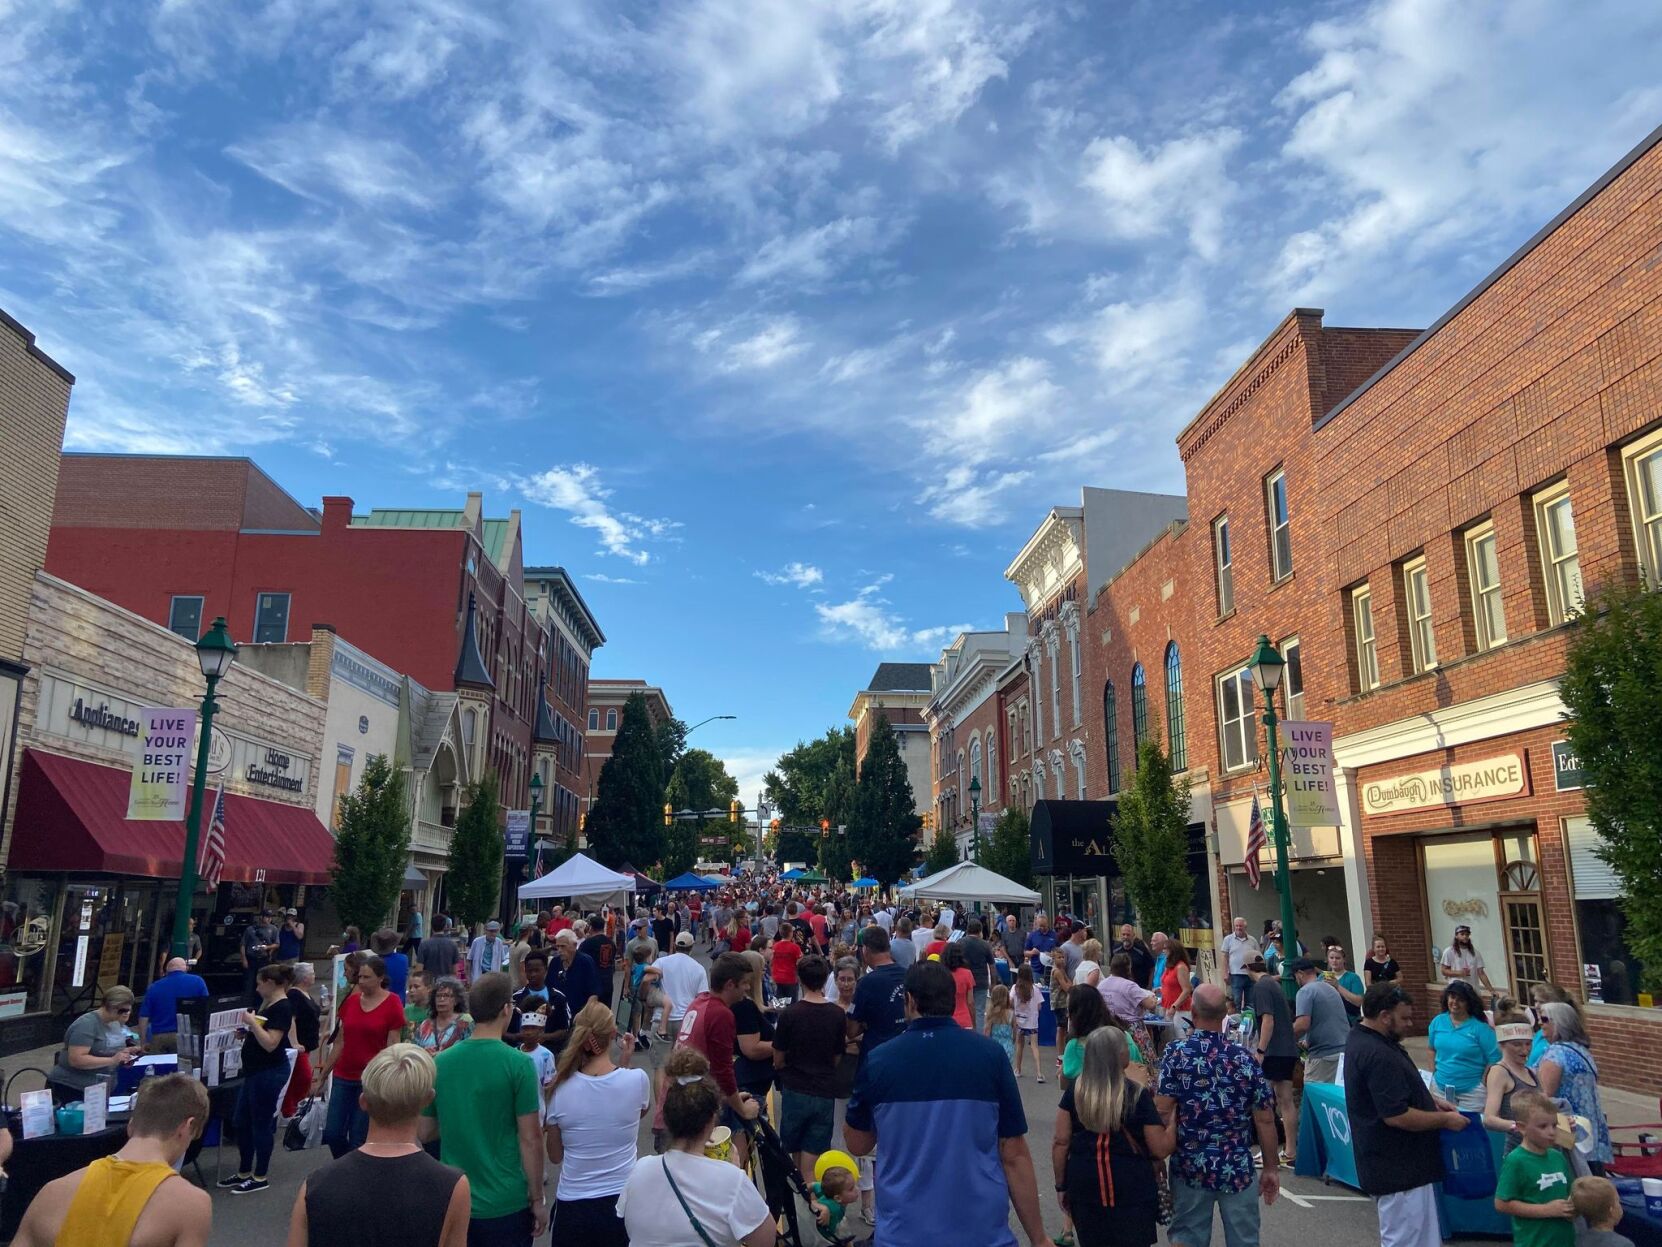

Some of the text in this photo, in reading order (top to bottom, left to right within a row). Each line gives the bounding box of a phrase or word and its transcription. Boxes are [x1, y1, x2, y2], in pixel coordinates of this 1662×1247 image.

[72, 698, 140, 737] Appliances
[150, 719, 185, 731] LIVE
[144, 736, 187, 748] YOUR
[1291, 730, 1322, 742] LIVE
[266, 747, 290, 769] Home
[1290, 747, 1327, 758] YOUR
[143, 754, 183, 766] BEST
[1293, 764, 1327, 775] BEST
[141, 772, 180, 784] LIFE!
[248, 763, 303, 793] Entertainment
[1294, 780, 1329, 792] LIFE!
[1367, 764, 1519, 809] Dumbaugh INSURANCE
[1071, 837, 1085, 848] the
[255, 868, 266, 882] 121
